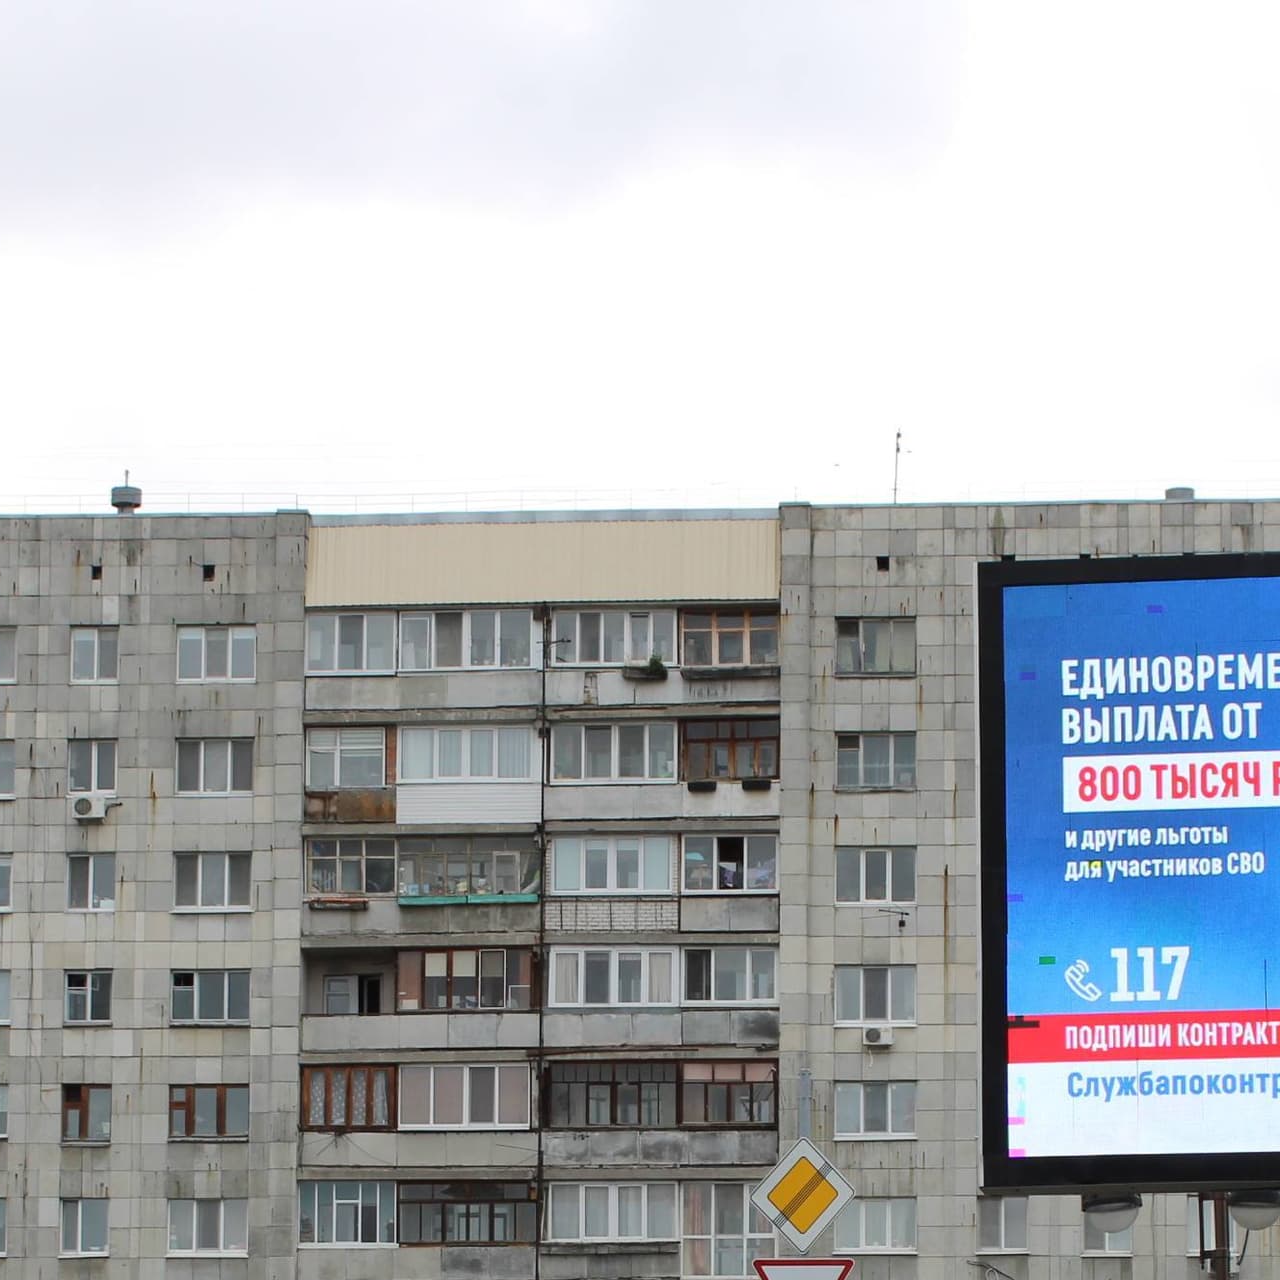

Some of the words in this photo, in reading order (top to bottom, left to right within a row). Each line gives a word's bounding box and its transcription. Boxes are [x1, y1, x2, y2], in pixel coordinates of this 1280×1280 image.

[1061, 704, 1214, 744] ВЫПЛАТА
[1222, 702, 1262, 739] ОТ
[1078, 764, 1142, 802] 800
[1150, 761, 1262, 800] ТЫСЯЧ
[1064, 830, 1077, 849] и
[1080, 827, 1152, 852] другие
[1154, 826, 1228, 847] льготы
[1064, 859, 1102, 882] для
[1105, 857, 1223, 883] участников
[1226, 851, 1265, 875] СВО
[1109, 945, 1191, 1002] 117
[1065, 1022, 1171, 1052] ПОДПИШИ
[1176, 1020, 1280, 1048] КОНТРАКТ
